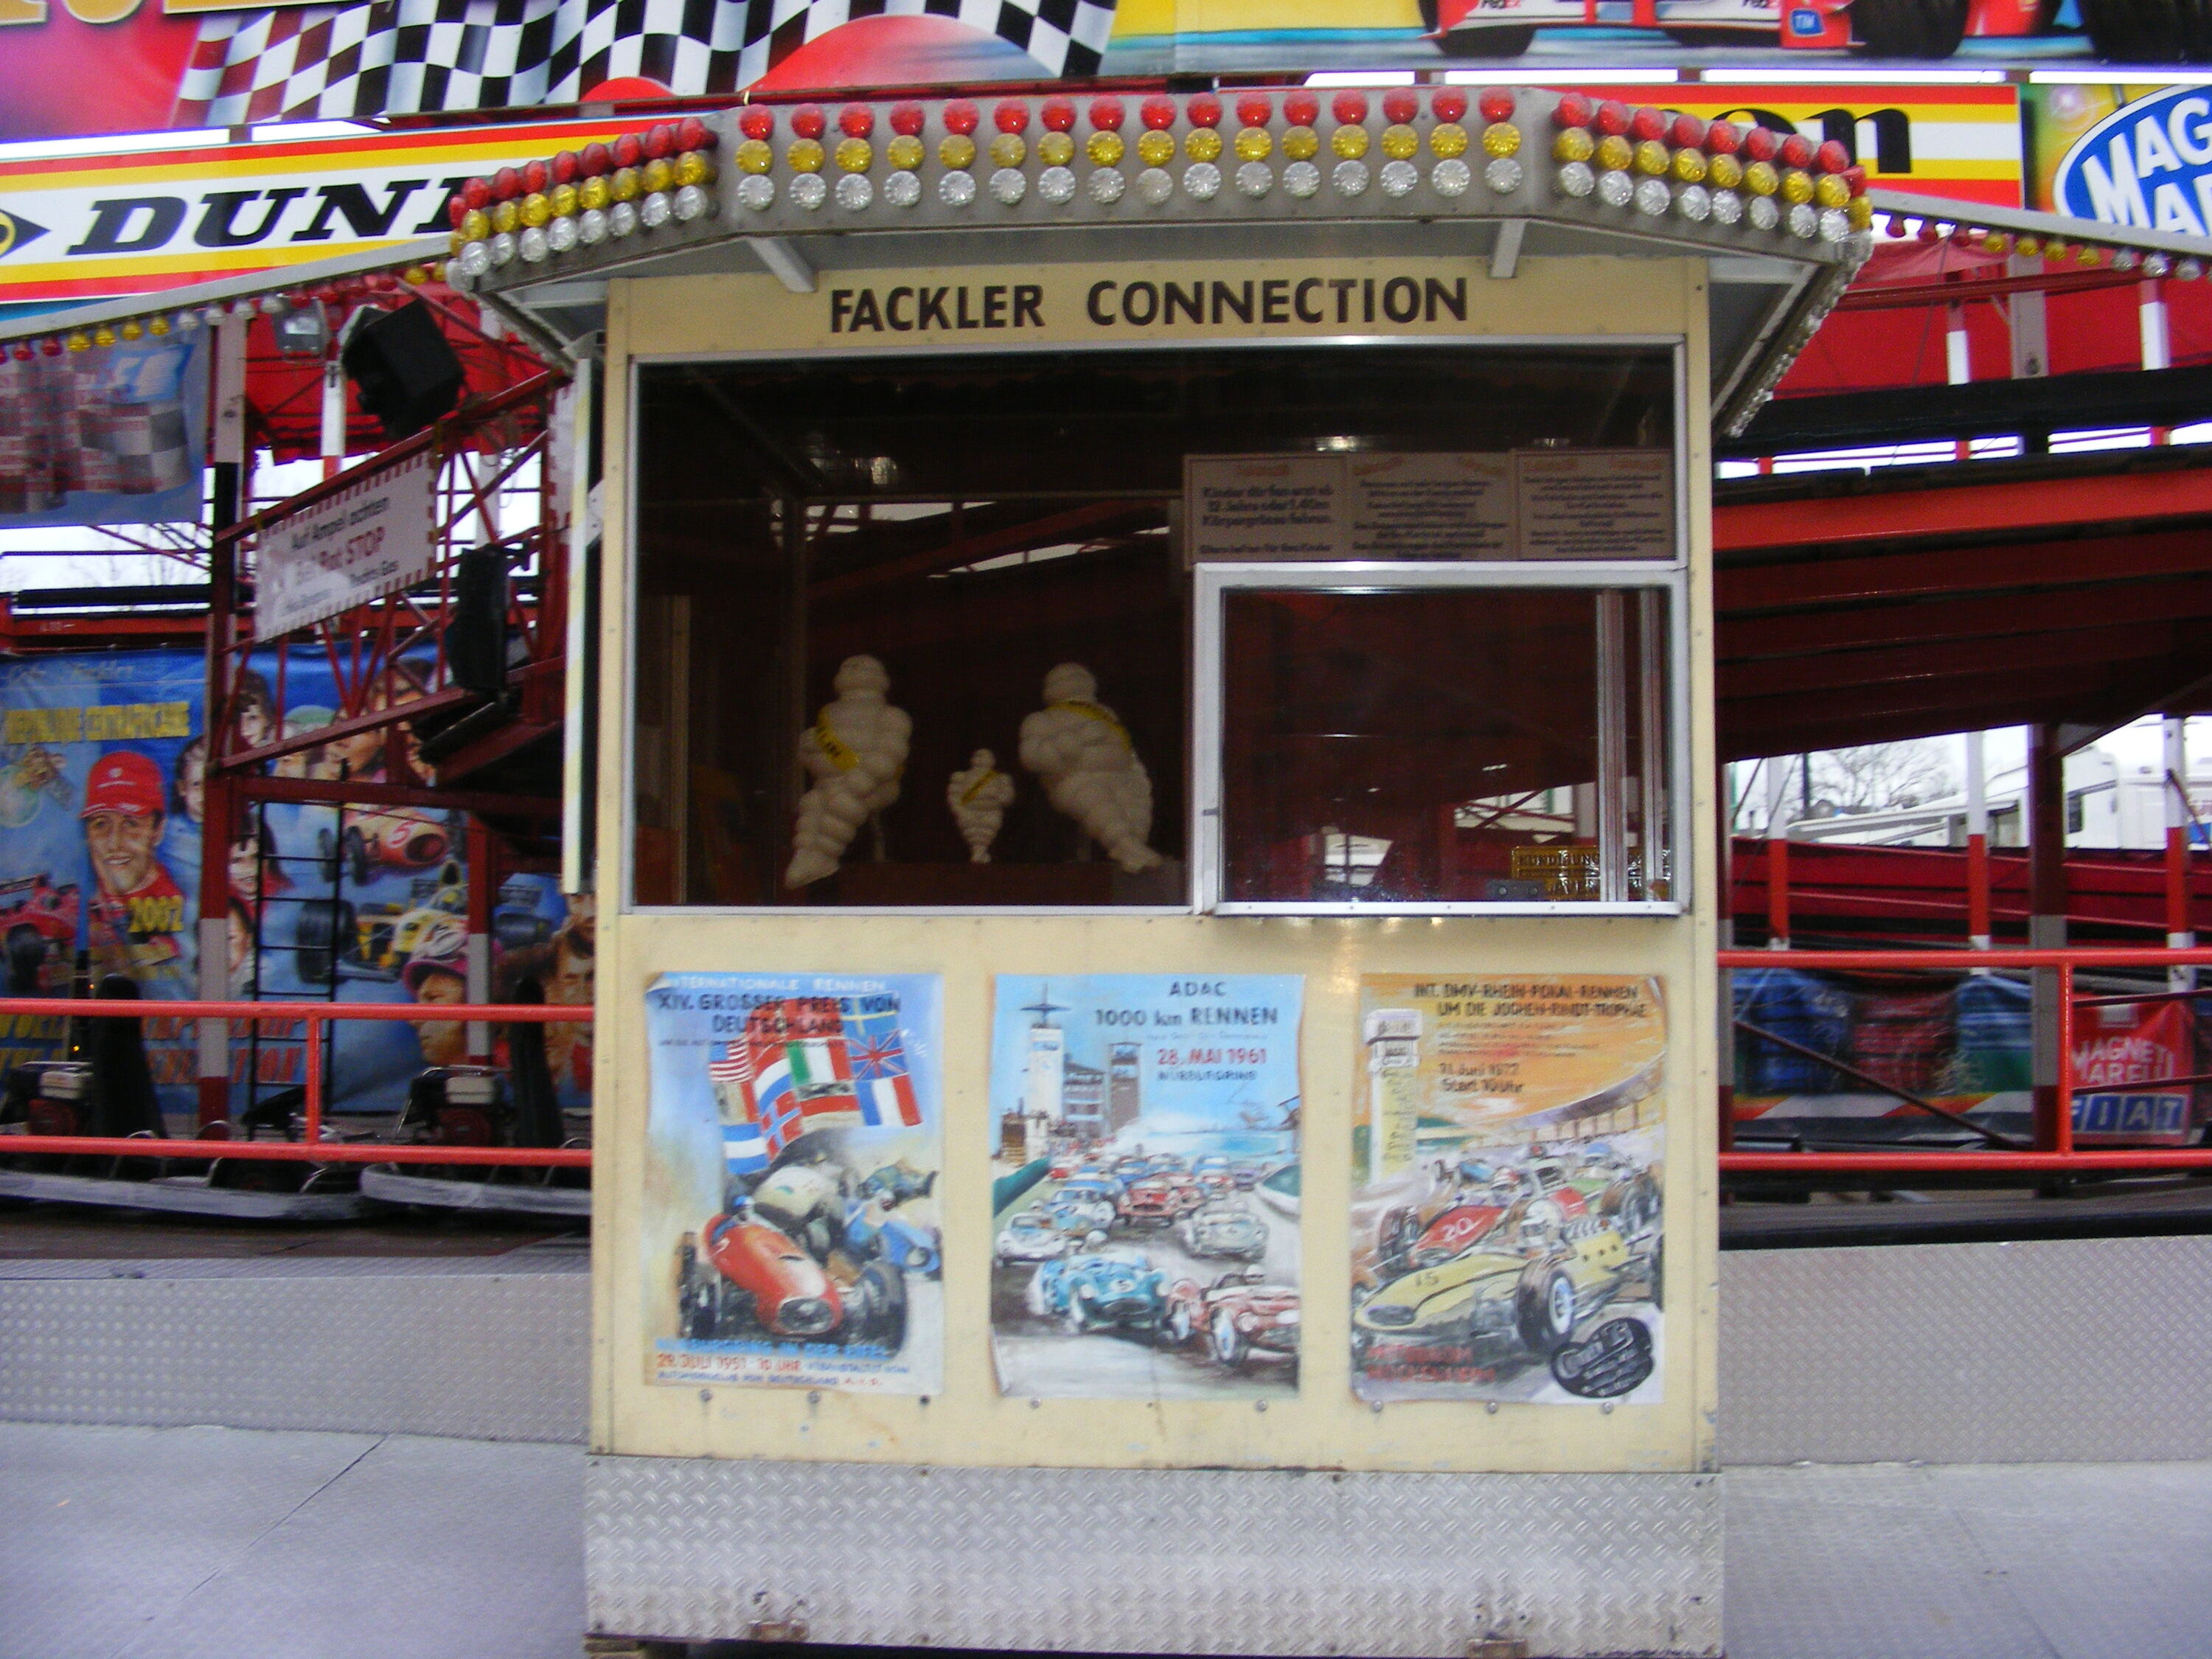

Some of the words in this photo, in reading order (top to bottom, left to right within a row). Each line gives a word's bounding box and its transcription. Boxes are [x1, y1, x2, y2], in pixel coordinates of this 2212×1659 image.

[831, 284, 1046, 333] FACKLER
[1087, 276, 1469, 327] CONNECTION
[347, 526, 386, 565] STOP
[1169, 981, 1228, 997] ADAC
[1096, 1008, 1147, 1026] 1000
[1154, 1010, 1183, 1026] km
[1190, 1006, 1279, 1025] RENNEN
[1187, 1048, 1222, 1064] MAI
[1227, 1048, 1267, 1065] 1961
[1442, 1217, 1472, 1241] 20
